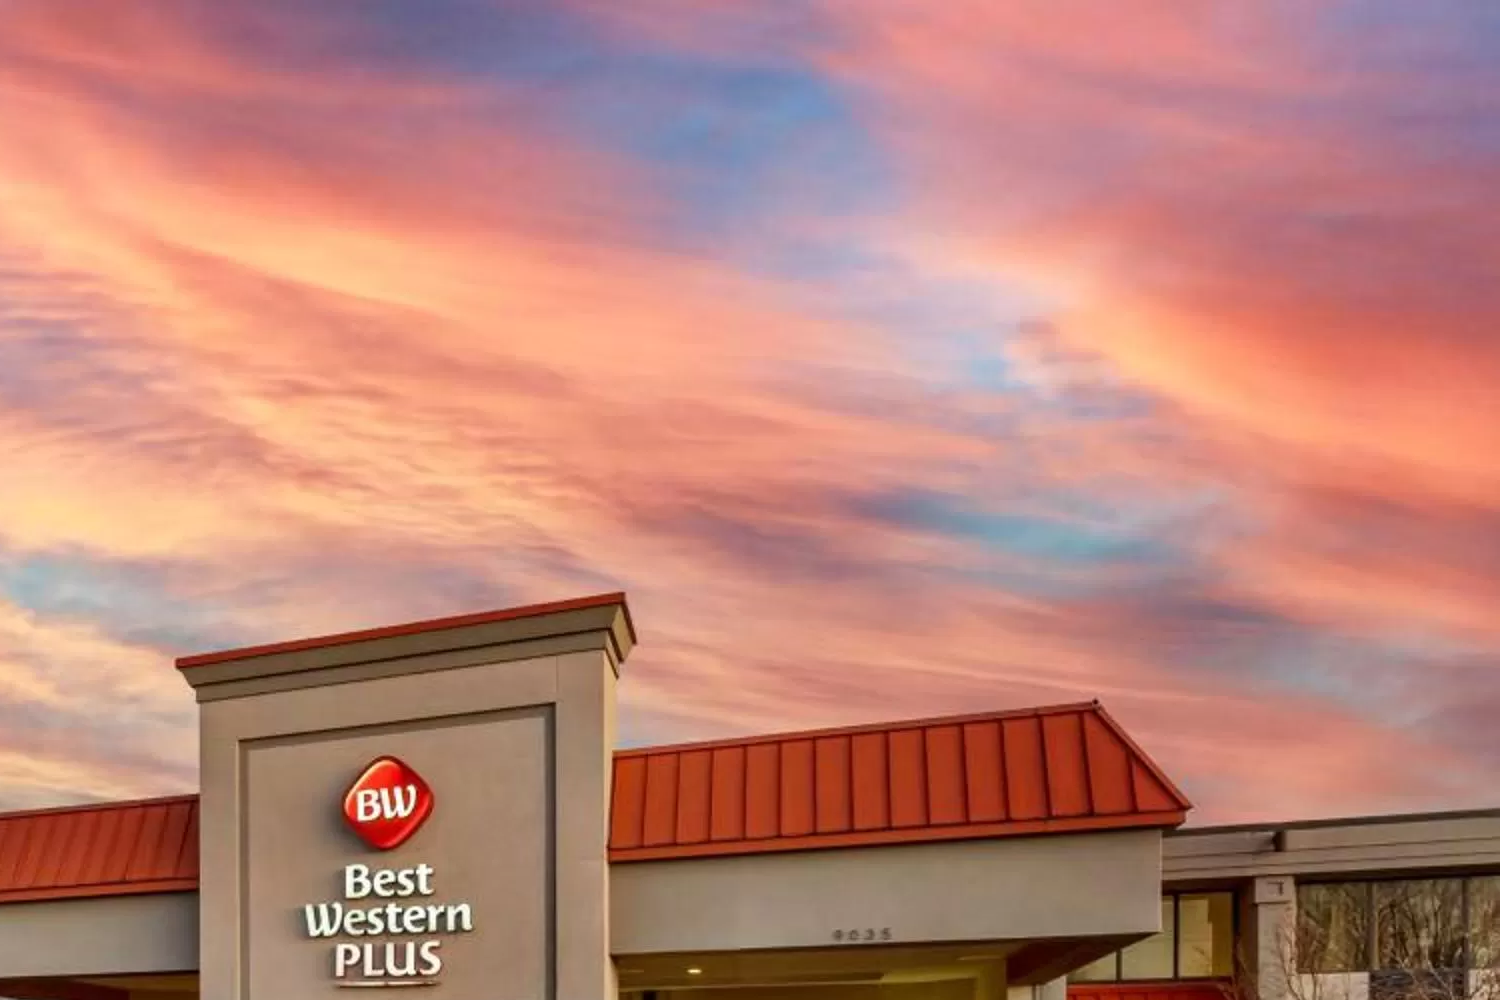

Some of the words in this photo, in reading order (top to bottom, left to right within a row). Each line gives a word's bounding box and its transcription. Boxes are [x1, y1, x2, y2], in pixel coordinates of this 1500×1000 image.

[356, 784, 417, 822] BW
[345, 863, 434, 898] Best
[304, 902, 473, 937] Western
[335, 940, 443, 977] PLUS
